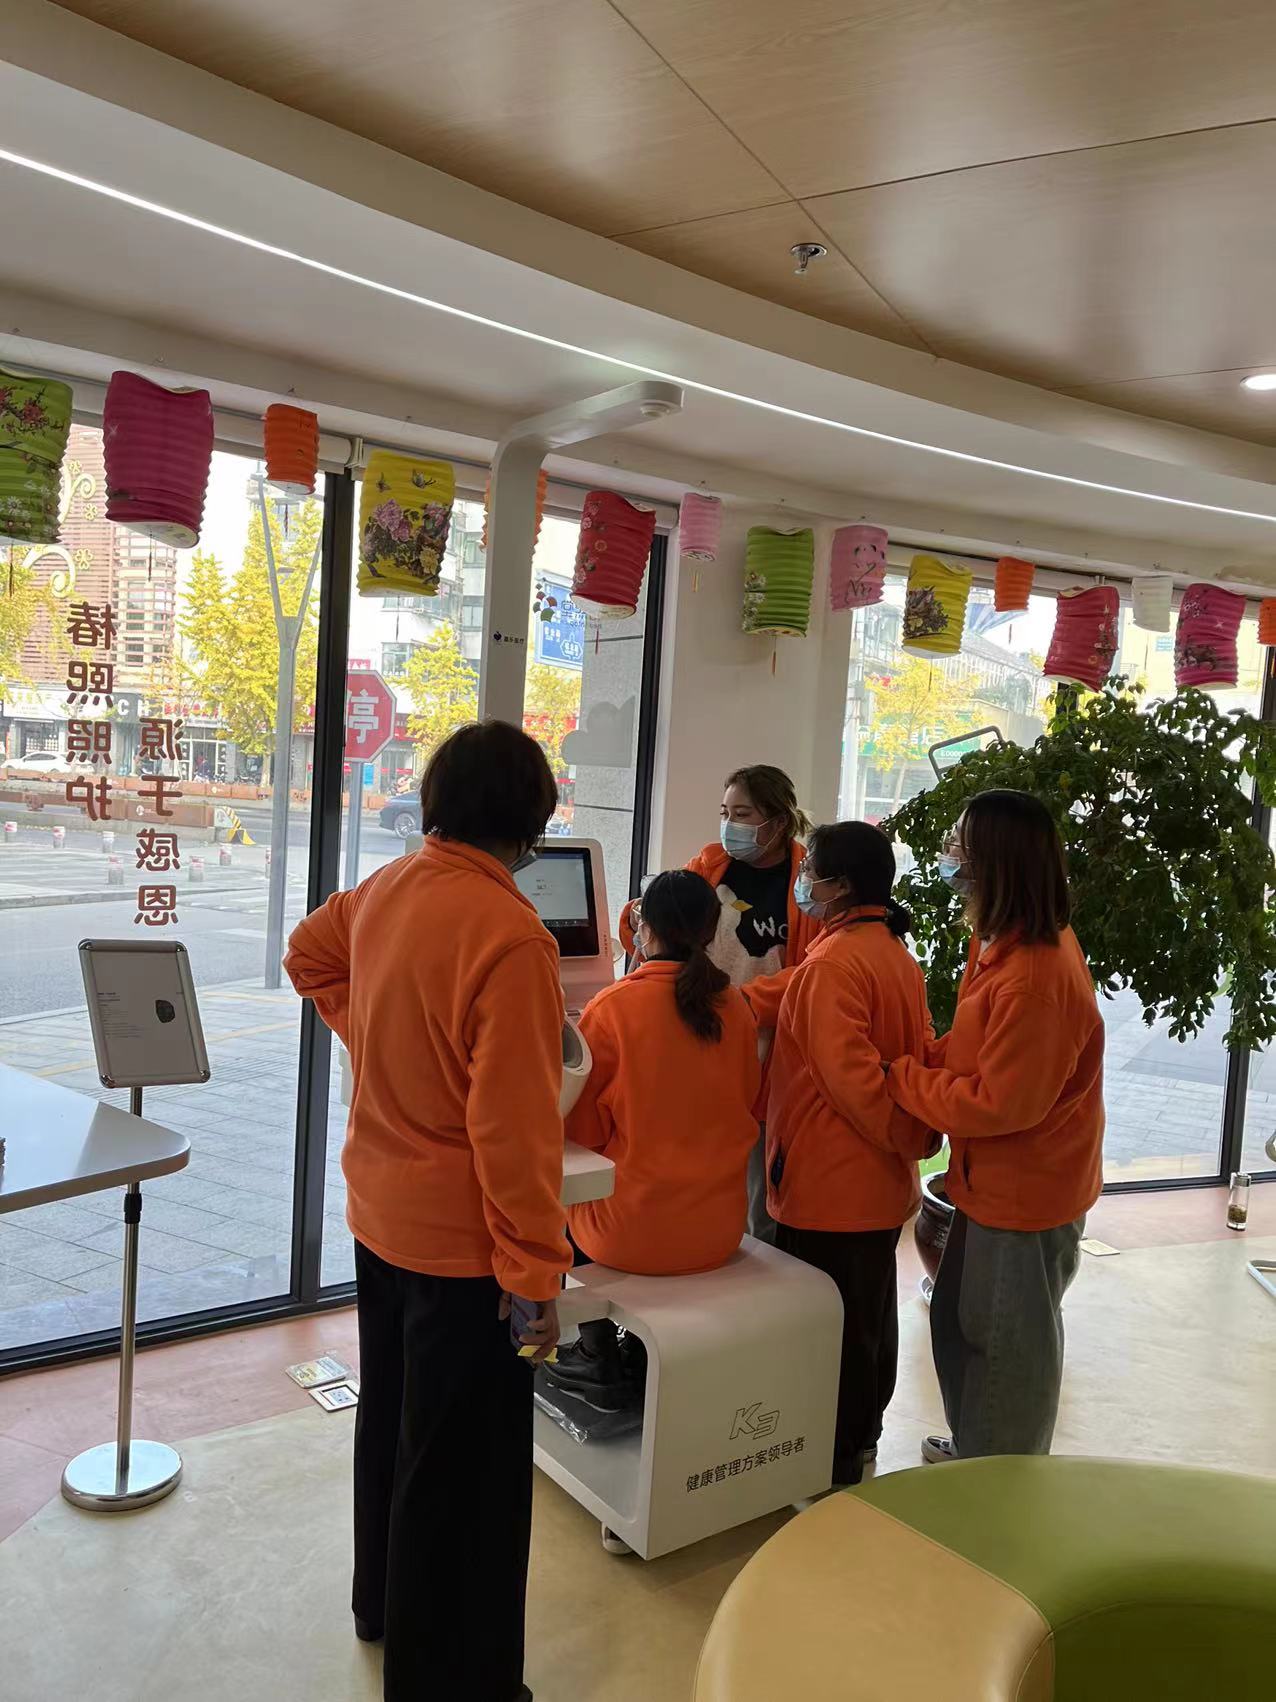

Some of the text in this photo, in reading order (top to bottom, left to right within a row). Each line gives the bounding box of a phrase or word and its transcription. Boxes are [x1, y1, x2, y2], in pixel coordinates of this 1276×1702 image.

[686, 1436, 806, 1493] 健康管理方案领导者
